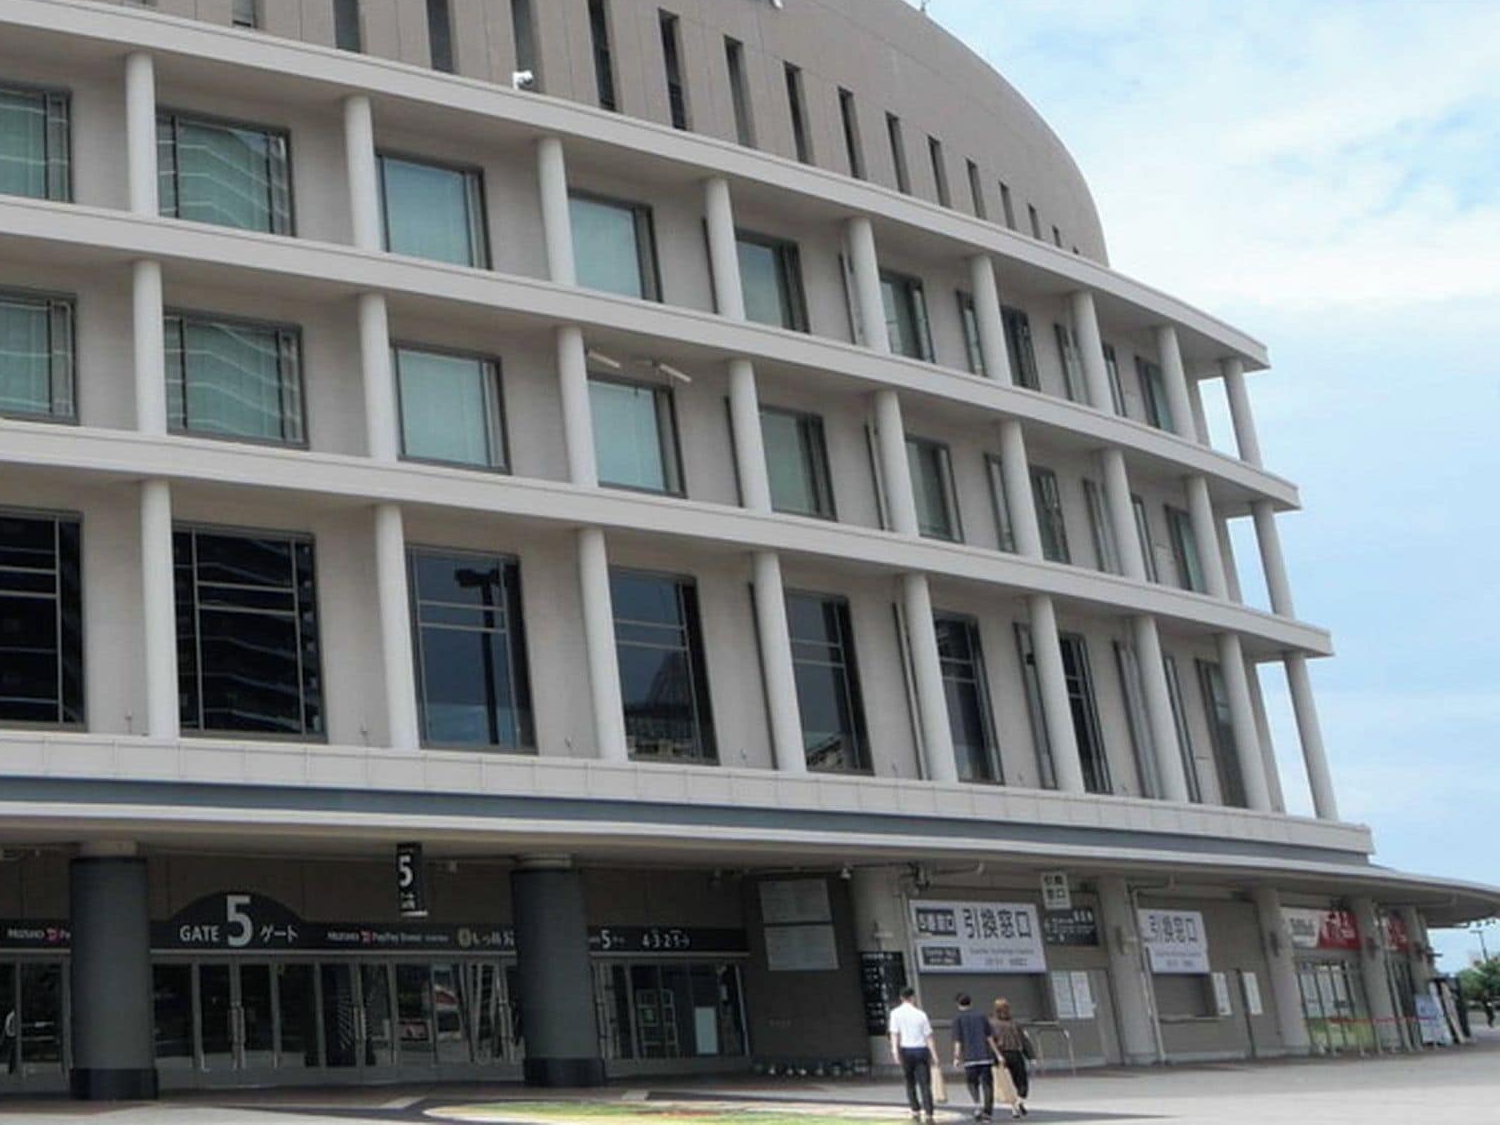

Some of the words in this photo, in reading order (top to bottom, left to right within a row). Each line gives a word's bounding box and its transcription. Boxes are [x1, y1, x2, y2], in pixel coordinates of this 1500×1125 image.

[399, 855, 413, 887] 5
[180, 925, 219, 942] GATE
[226, 894, 253, 947] 5
[260, 924, 298, 942] ゲート
[601, 929, 612, 949] 5
